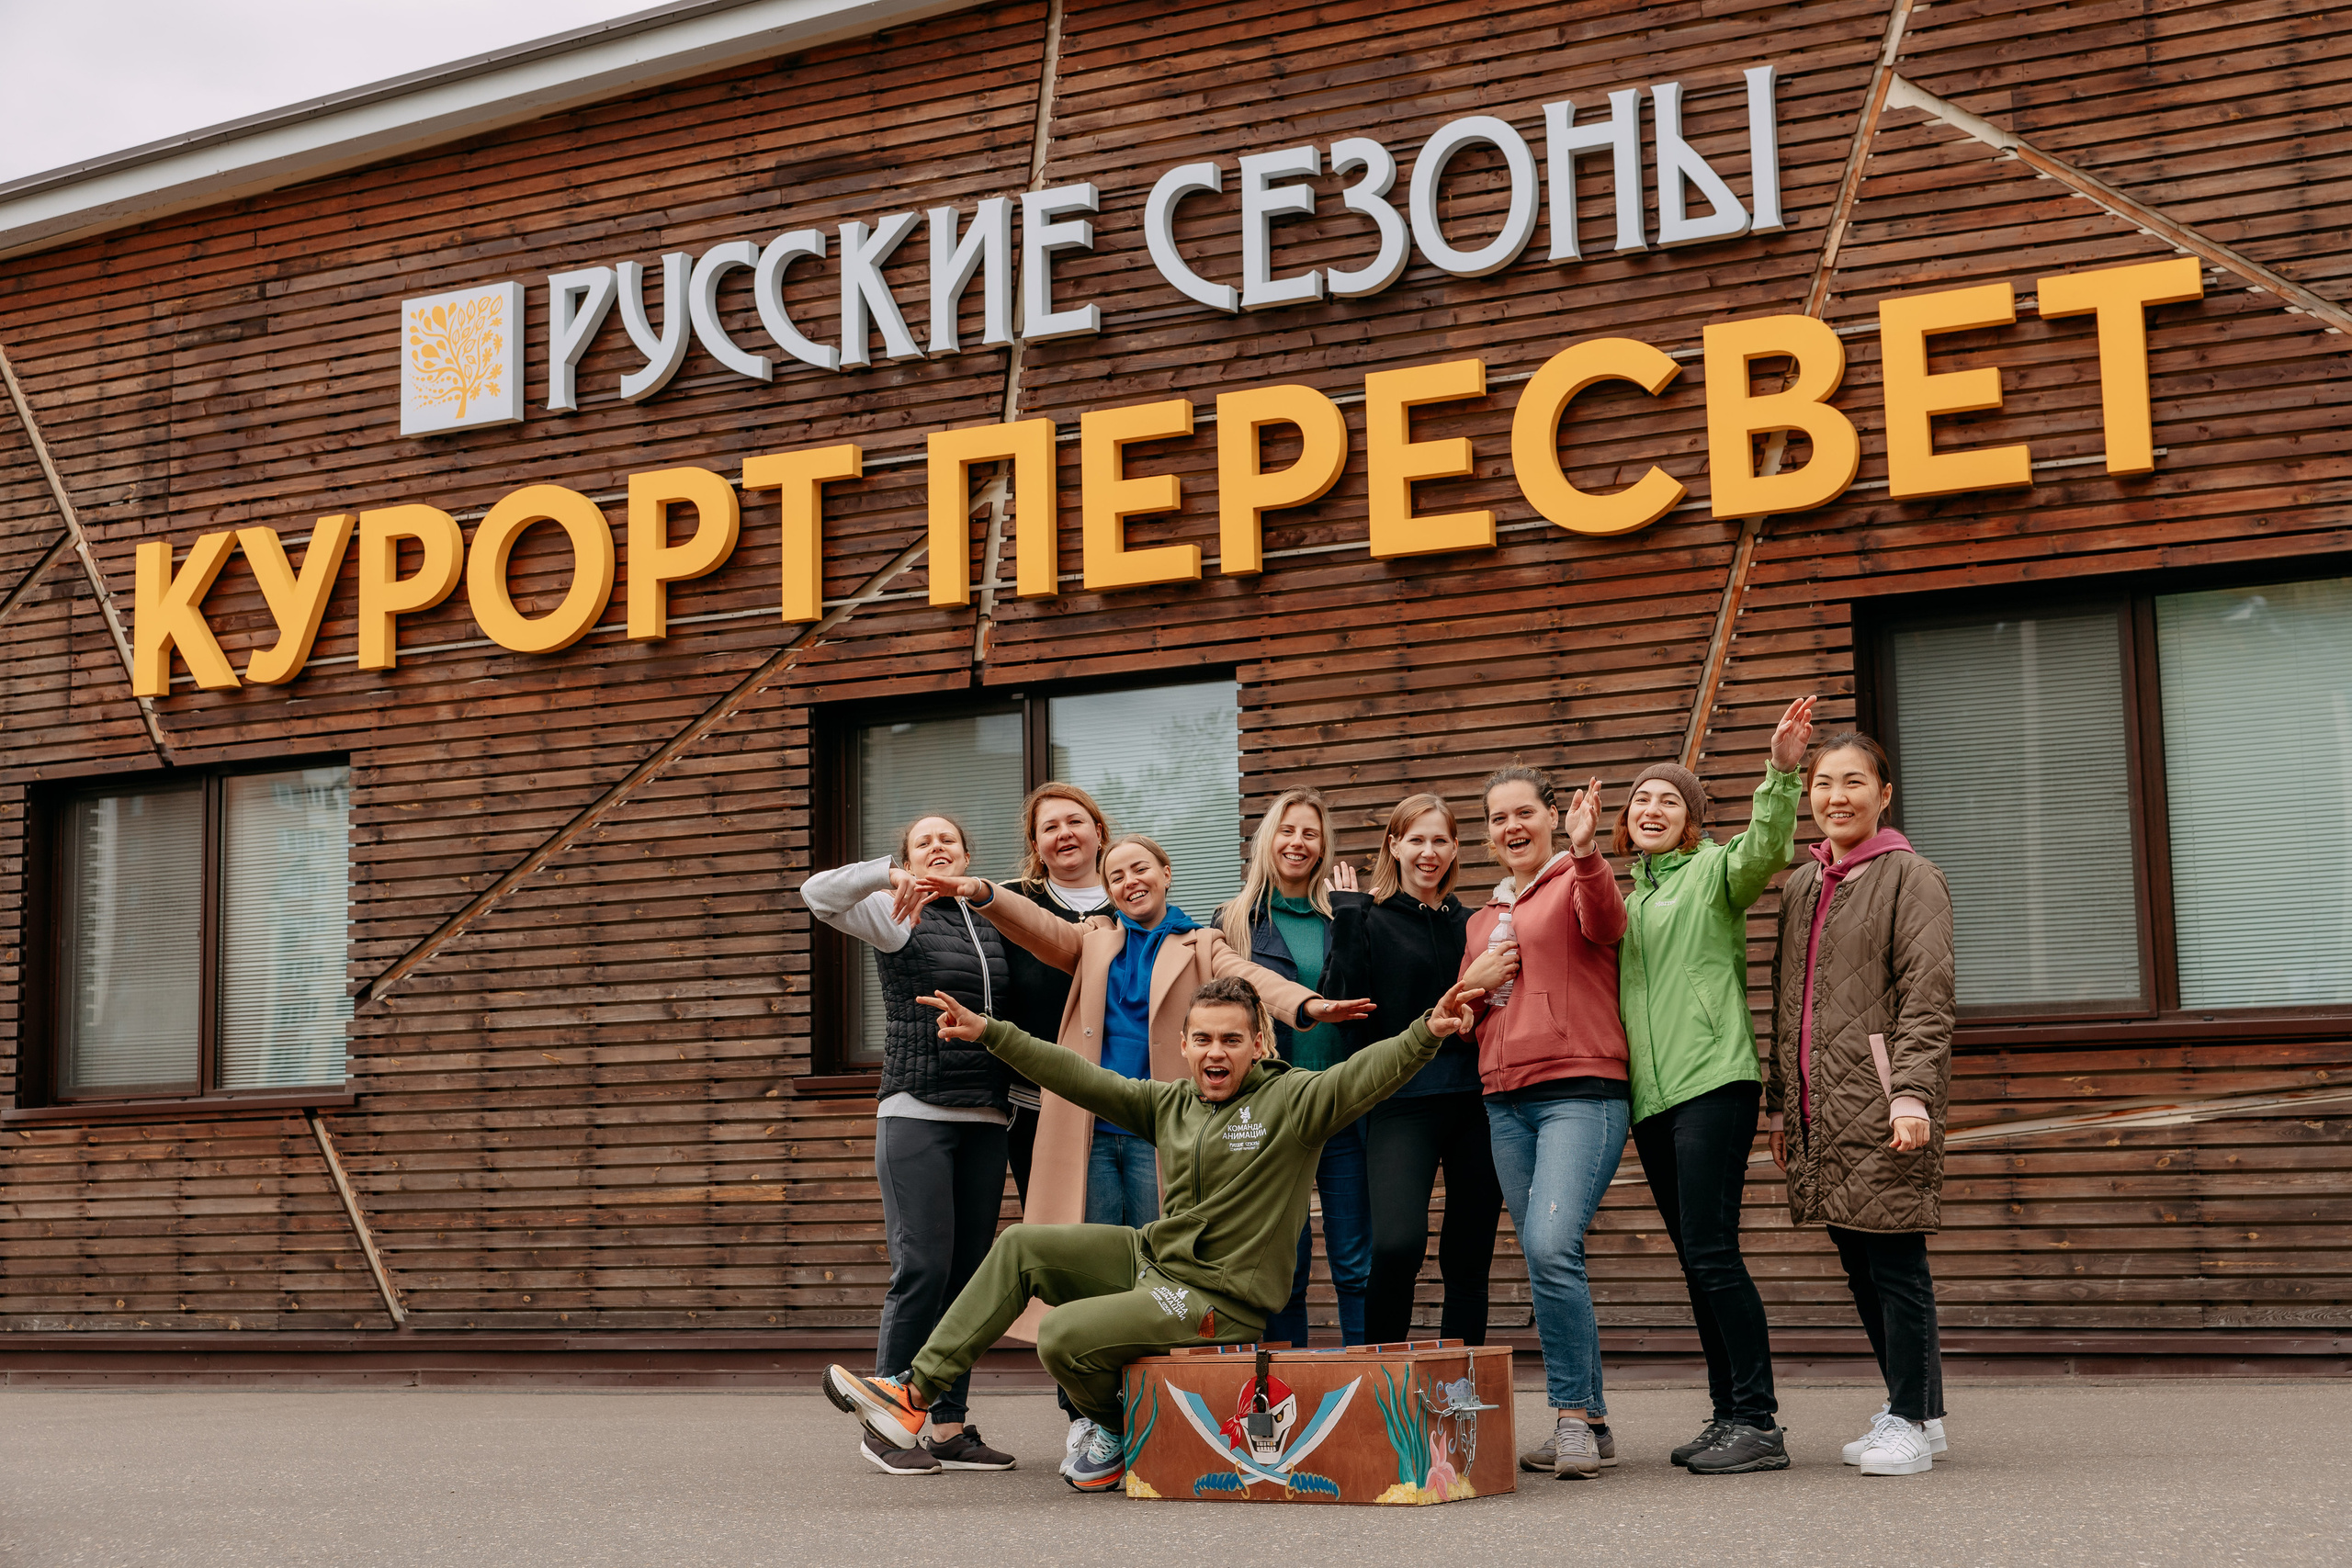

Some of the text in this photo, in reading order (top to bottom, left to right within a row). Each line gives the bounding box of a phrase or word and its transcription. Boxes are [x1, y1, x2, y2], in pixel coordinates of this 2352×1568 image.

[548, 65, 1786, 412] РУССКИЕ СЕЗОНЫ
[131, 256, 2204, 697] КУРОРТ ПЕРЕСВЕТ
[1222, 1128, 1267, 1140] АНИМАЦИИ
[1227, 1122, 1263, 1133] КОМАНДА
